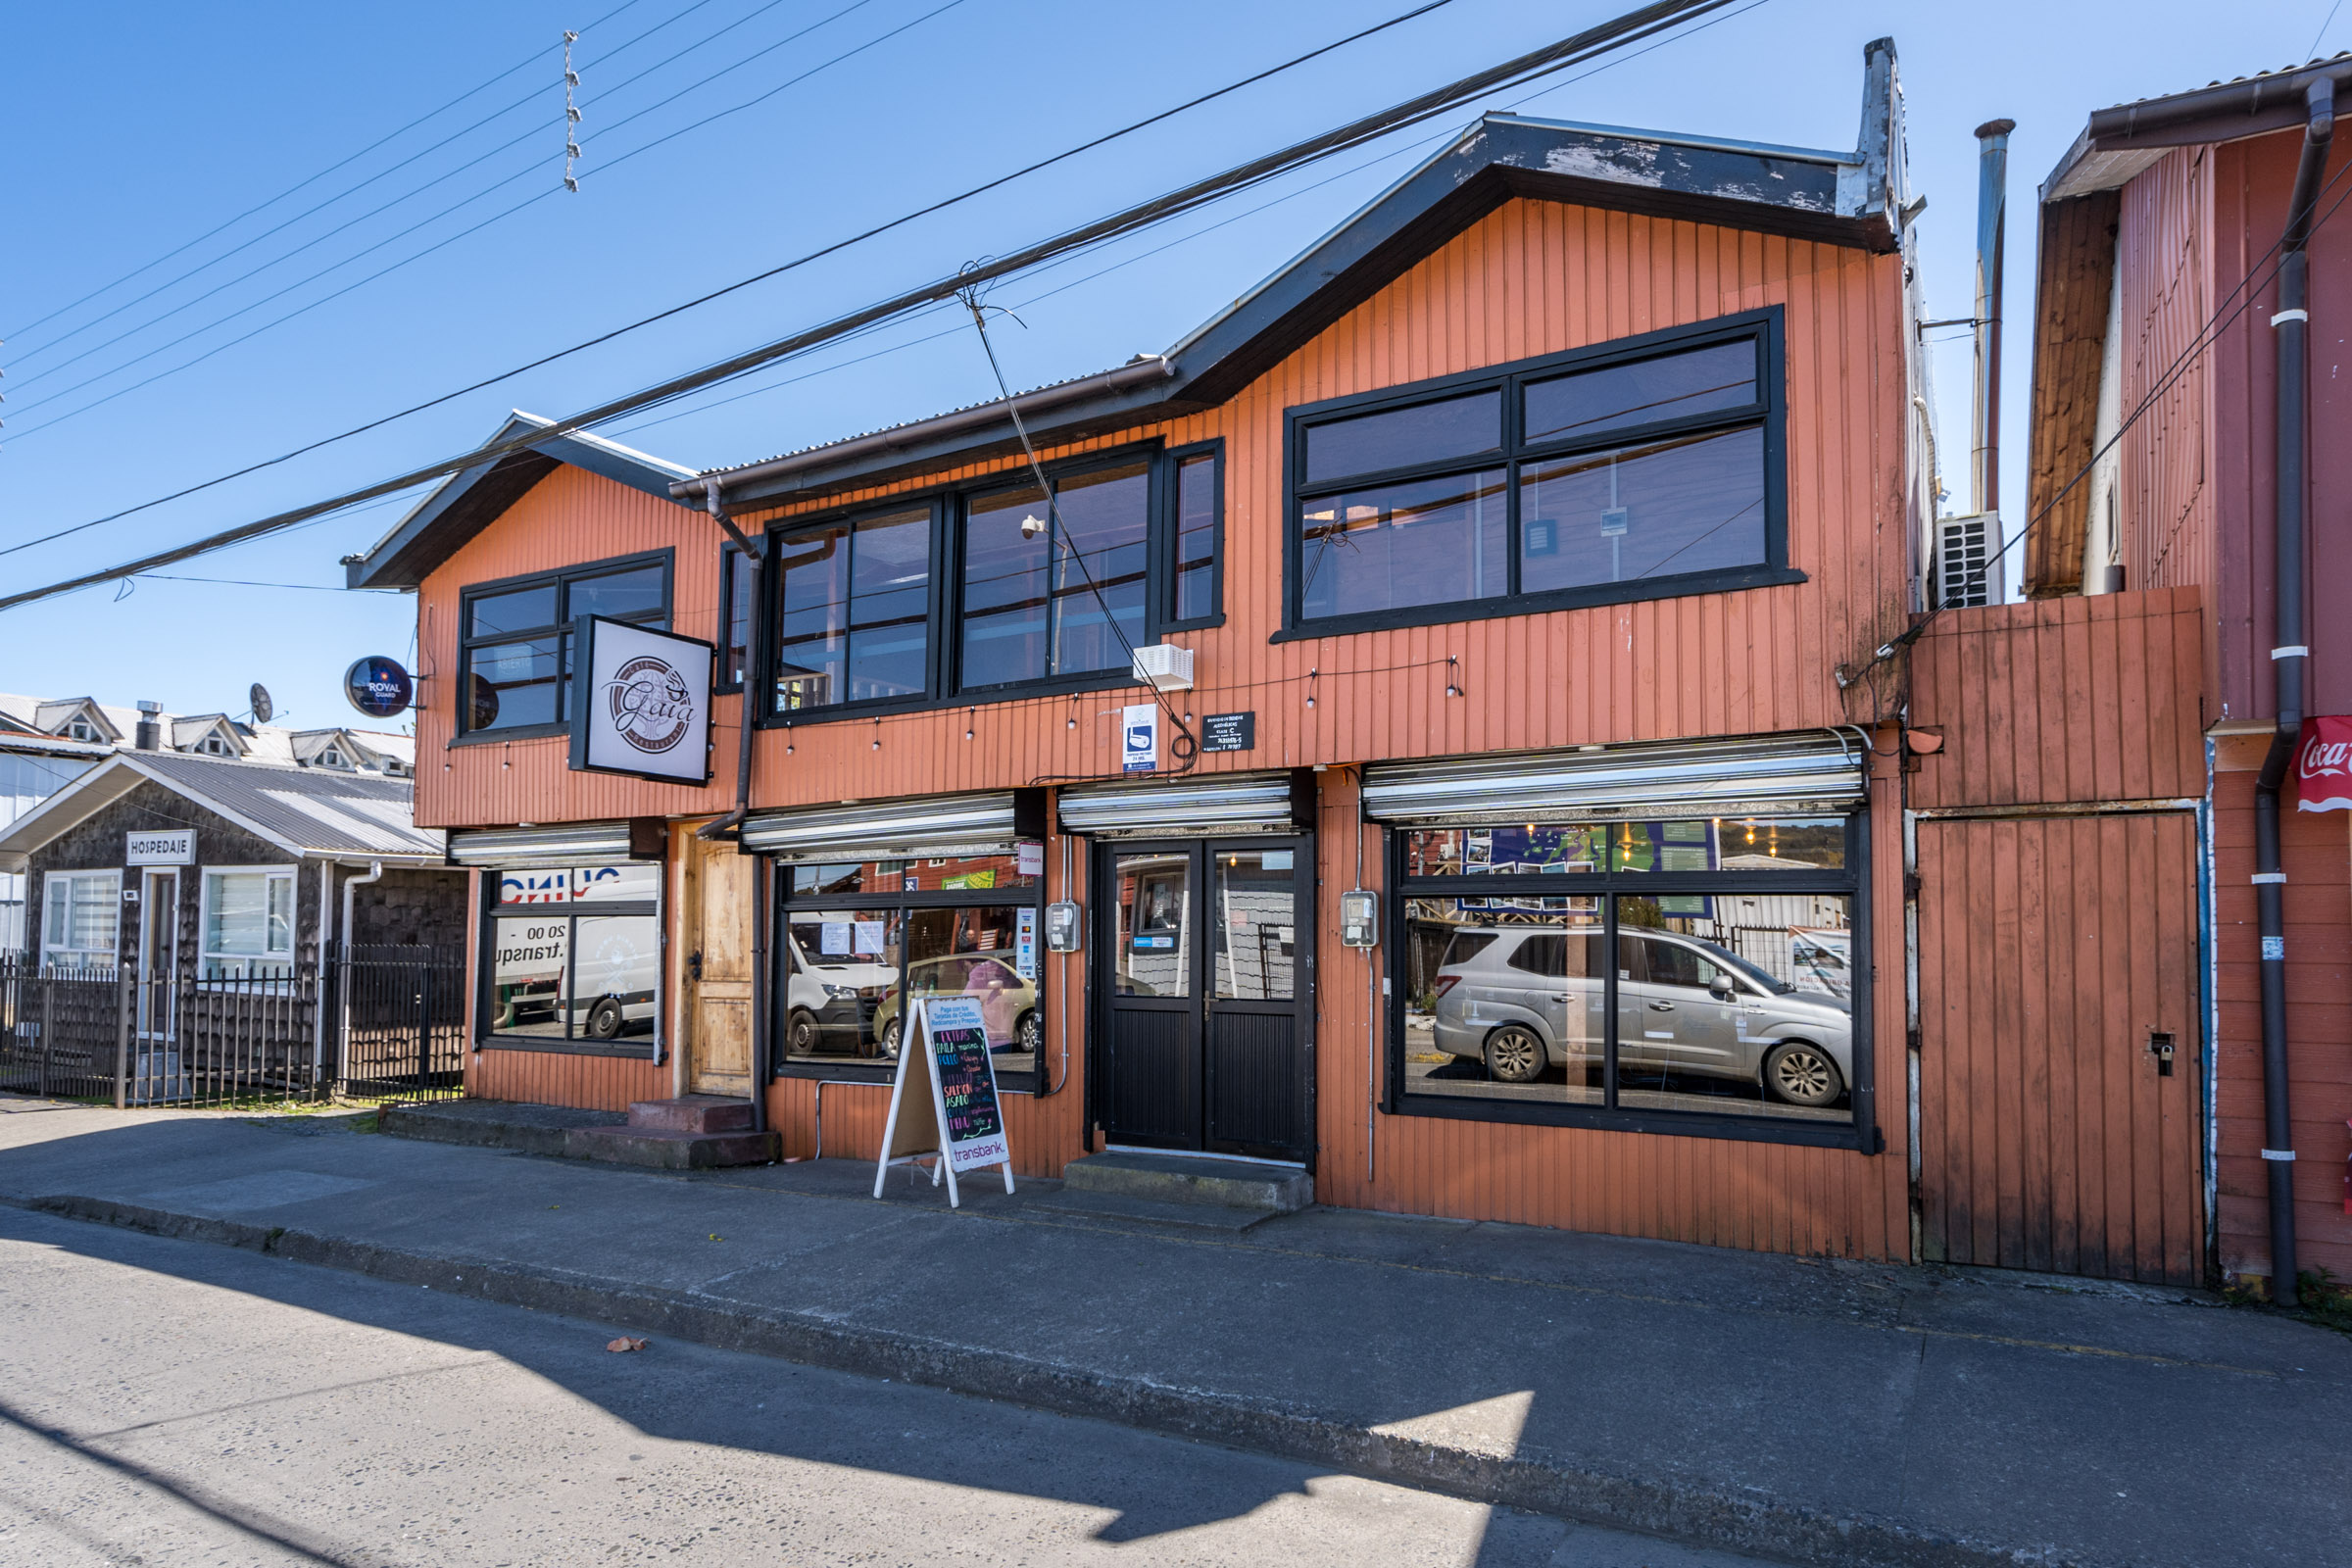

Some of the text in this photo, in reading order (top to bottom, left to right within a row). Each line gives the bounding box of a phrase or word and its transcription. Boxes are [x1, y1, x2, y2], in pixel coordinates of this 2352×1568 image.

[368, 682, 402, 693] ROYAL
[2300, 734, 2352, 779] Coca
[131, 839, 187, 855] HOSPEDAJE
[941, 1030, 970, 1043] EXTRAS
[946, 1094, 969, 1108] ASADO
